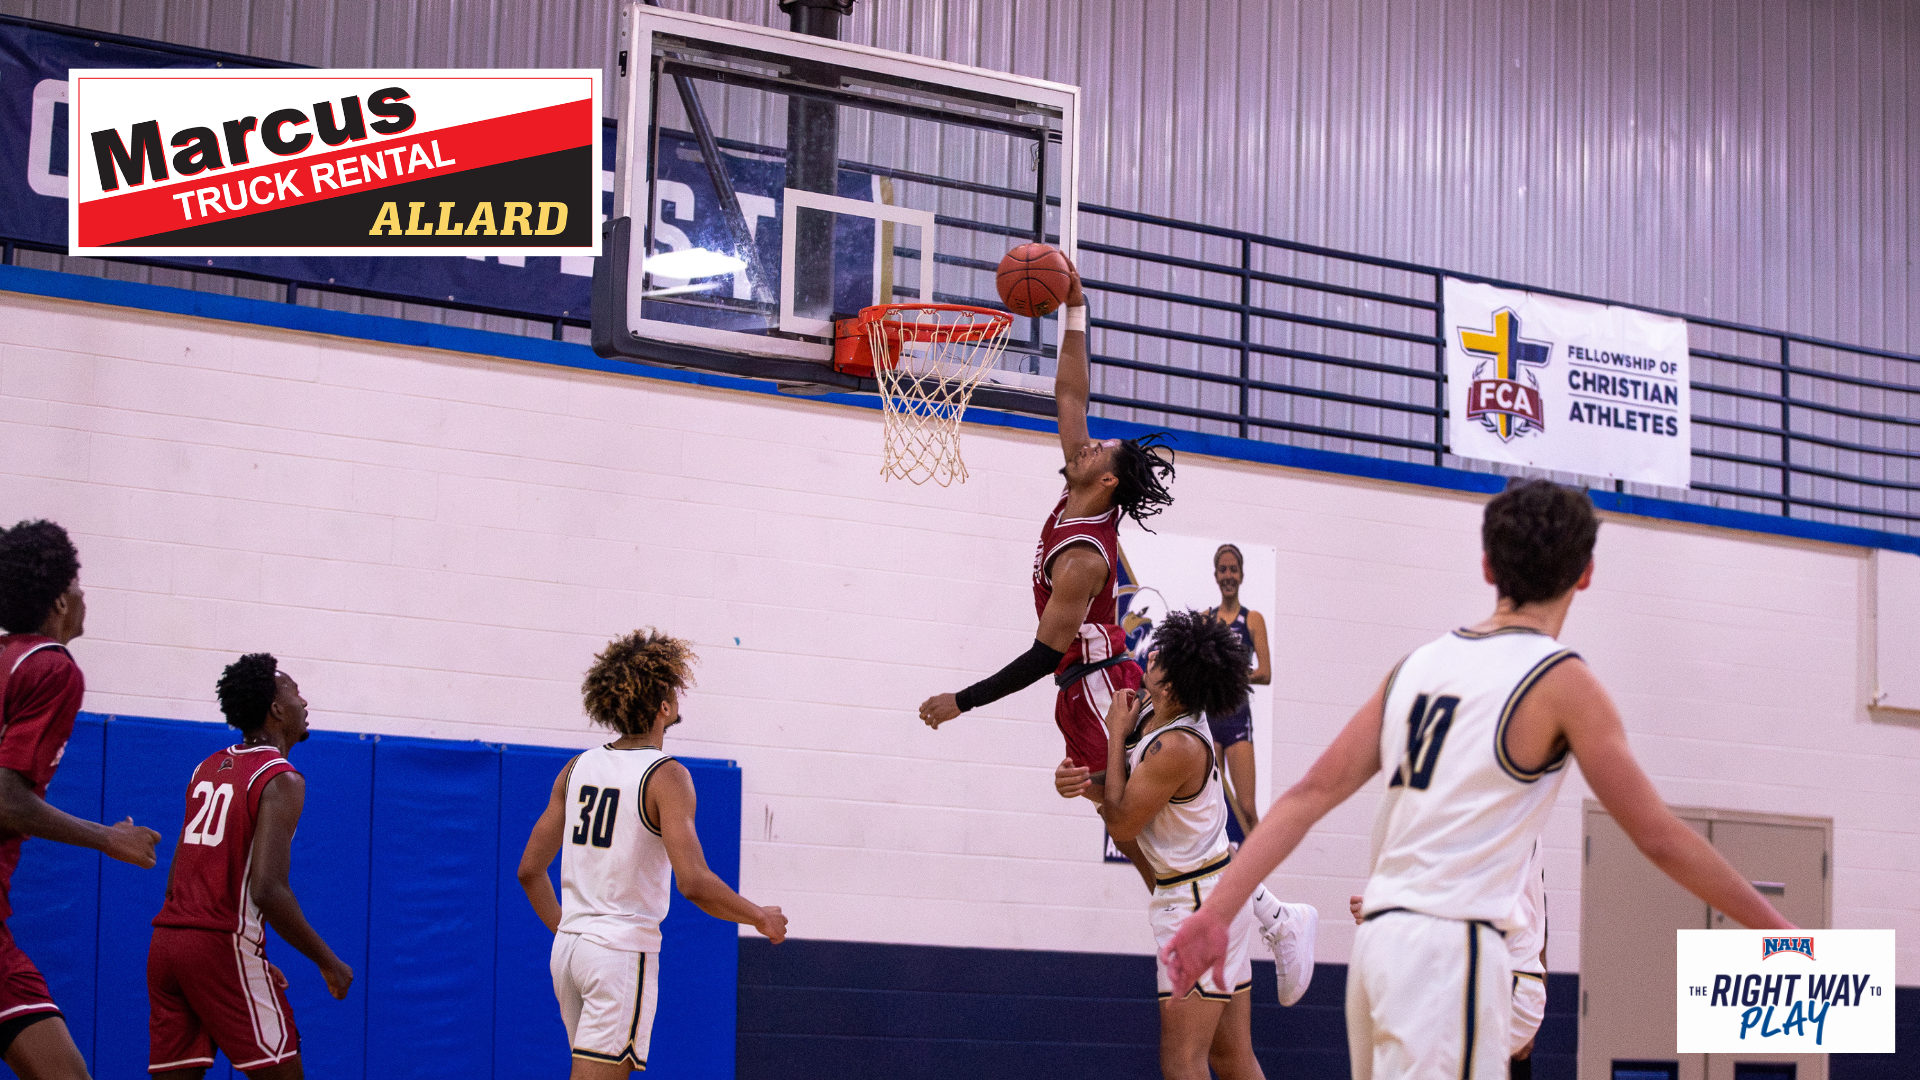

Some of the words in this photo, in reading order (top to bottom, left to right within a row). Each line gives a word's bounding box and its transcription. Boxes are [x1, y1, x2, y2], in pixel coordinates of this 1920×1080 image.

[1567, 345, 1656, 371] FELLOWSHIP
[1660, 361, 1678, 375] OF
[1479, 382, 1534, 416] FCA
[1568, 369, 1678, 405] CHRISTIAN
[1569, 401, 1678, 437] ATHLETES
[183, 780, 235, 848] 20
[571, 784, 621, 850] 30
